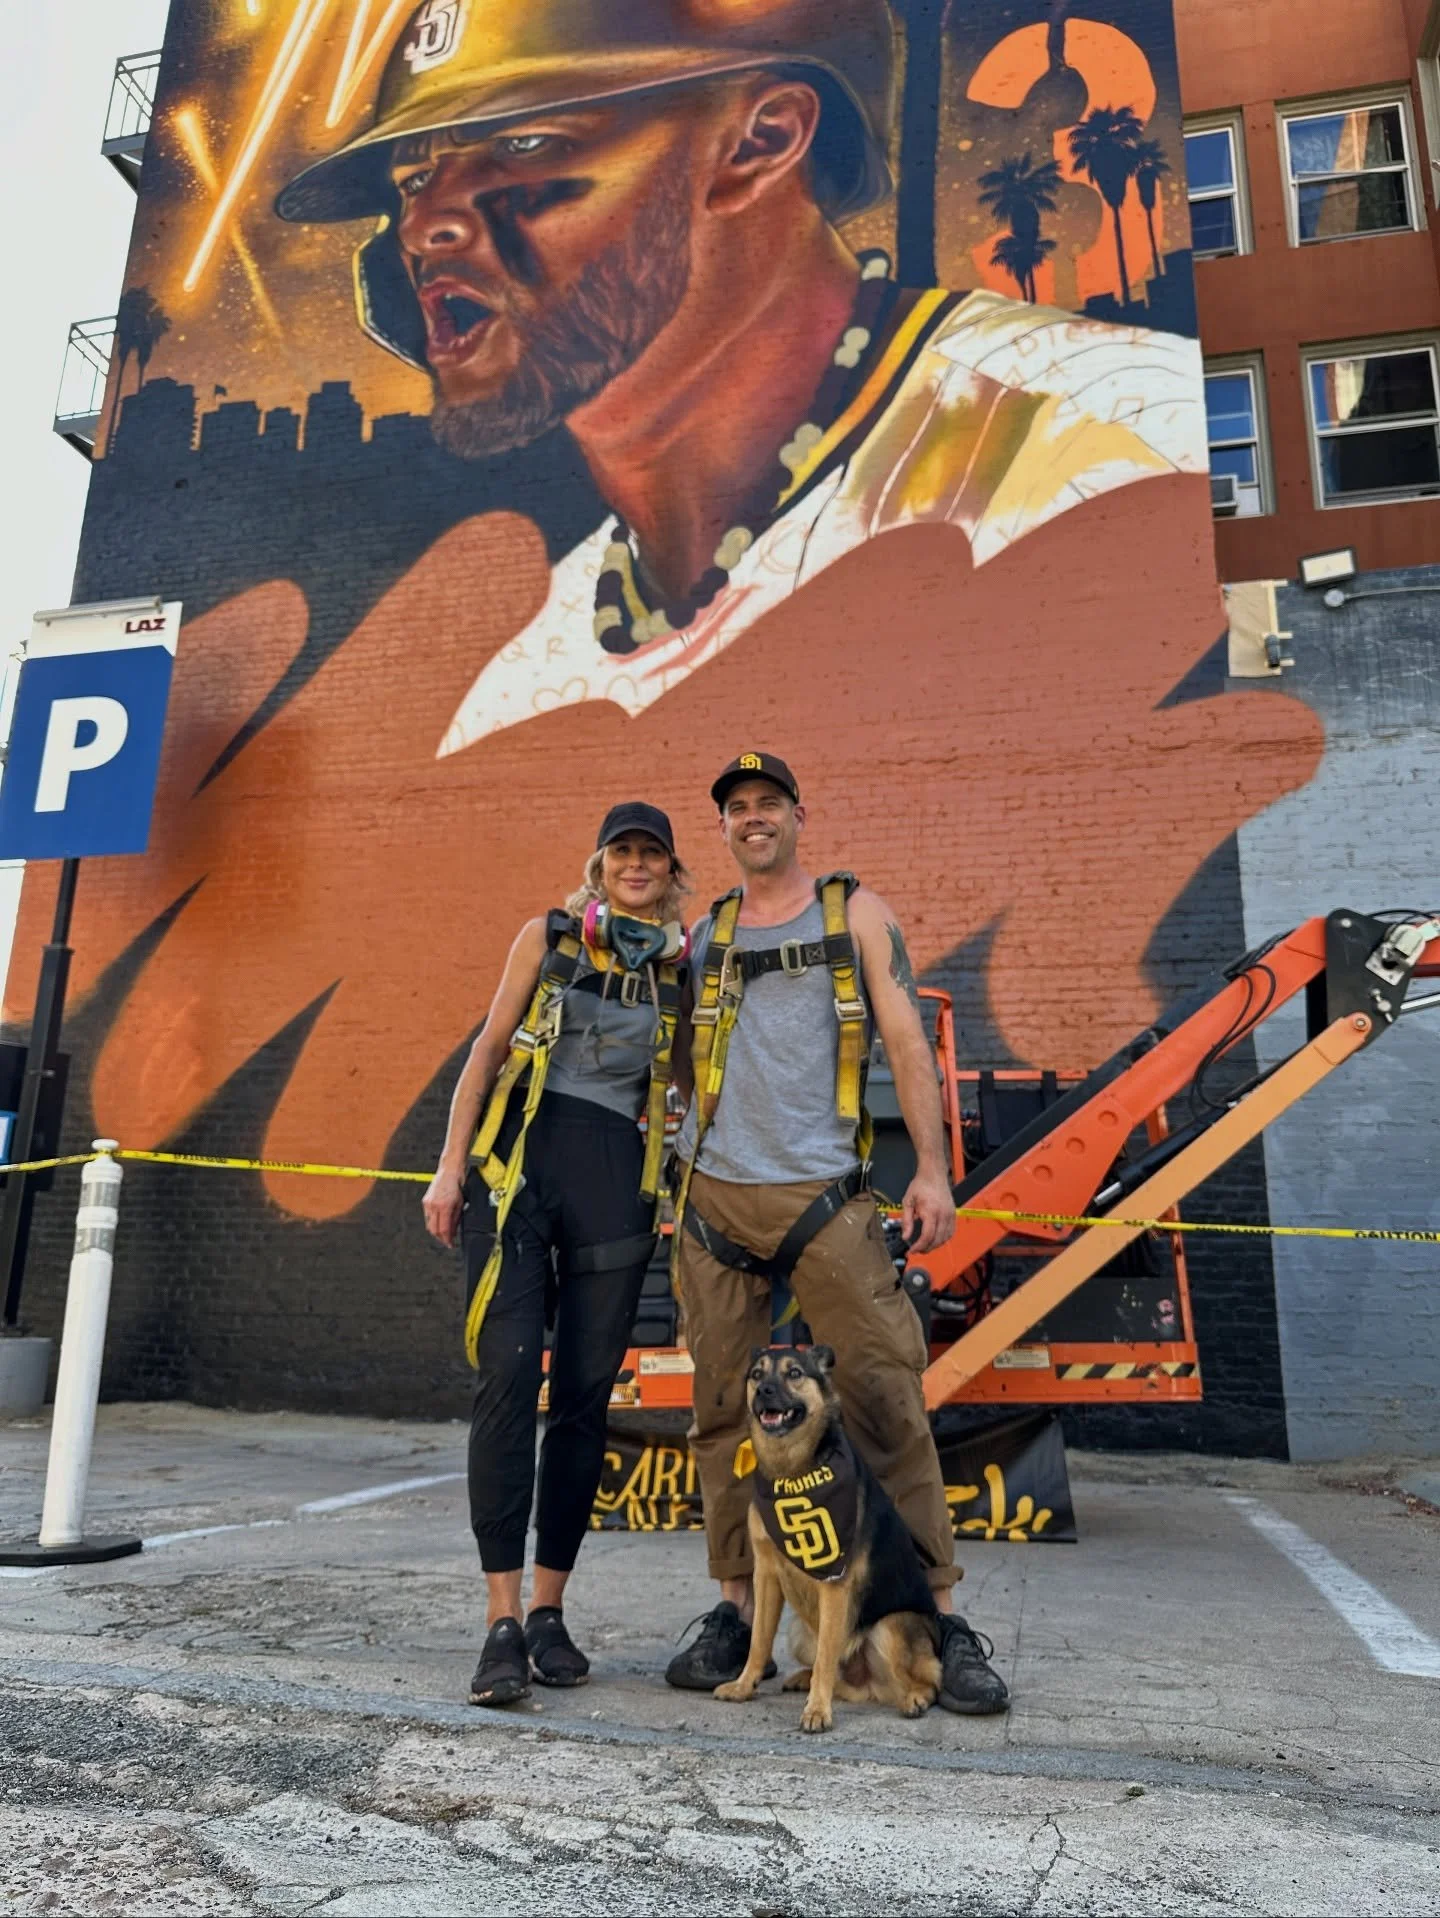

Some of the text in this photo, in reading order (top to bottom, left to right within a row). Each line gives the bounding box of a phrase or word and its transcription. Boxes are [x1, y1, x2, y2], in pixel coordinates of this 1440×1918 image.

[125, 617, 166, 634] LAZ
[34, 696, 129, 813] P
[774, 1496, 840, 1569] SD
